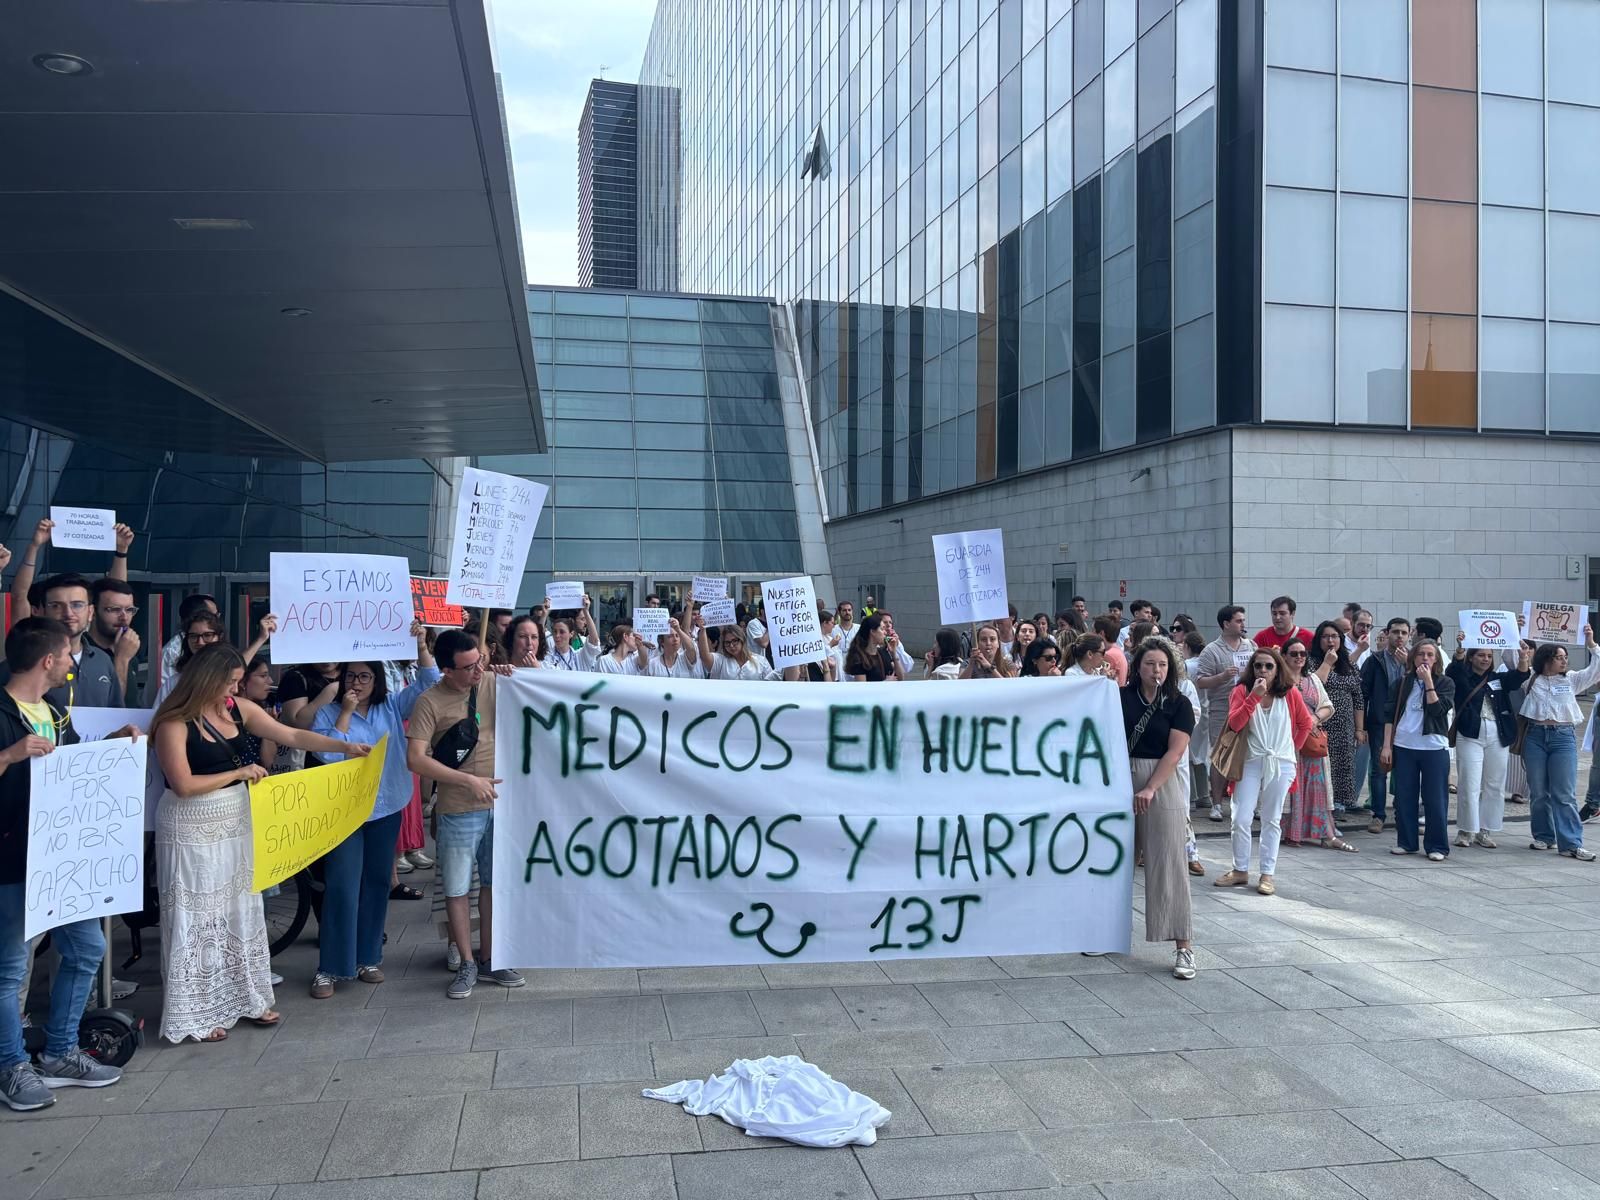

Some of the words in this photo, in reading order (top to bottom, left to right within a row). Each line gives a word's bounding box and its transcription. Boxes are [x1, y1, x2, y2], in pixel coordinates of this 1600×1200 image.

[945, 543, 993, 564] GUARDIA
[958, 567, 974, 580] DE
[974, 563, 991, 577] 24H
[1573, 561, 1581, 574] 3
[303, 569, 393, 593] ESTAMOS
[458, 584, 485, 600] TOTAL
[767, 587, 806, 600] NUESTRA
[774, 600, 807, 611] FATIGA
[959, 587, 1003, 608] COTIZADAS
[281, 599, 405, 633] AGOTADOS
[771, 615, 785, 625] TU
[791, 611, 813, 623] PEOR
[1536, 602, 1575, 613] HUELGA
[779, 624, 815, 637] ENEMIGA
[521, 680, 801, 778] MÉDICOS
[826, 703, 900, 773] EN
[915, 708, 1112, 786] HUELGA
[44, 747, 139, 787] HUELGA
[70, 774, 120, 808] POR
[271, 782, 310, 816] POR
[326, 767, 361, 801] UNA
[33, 796, 143, 836] DIGNIDAD
[265, 807, 342, 854] SANIDAD
[45, 832, 69, 856] NO
[523, 813, 802, 887] AGOTADOS
[837, 813, 879, 881] Y
[914, 811, 1130, 880] HARTOS
[27, 854, 138, 912] CAPRICHO
[868, 894, 982, 953] 13J
